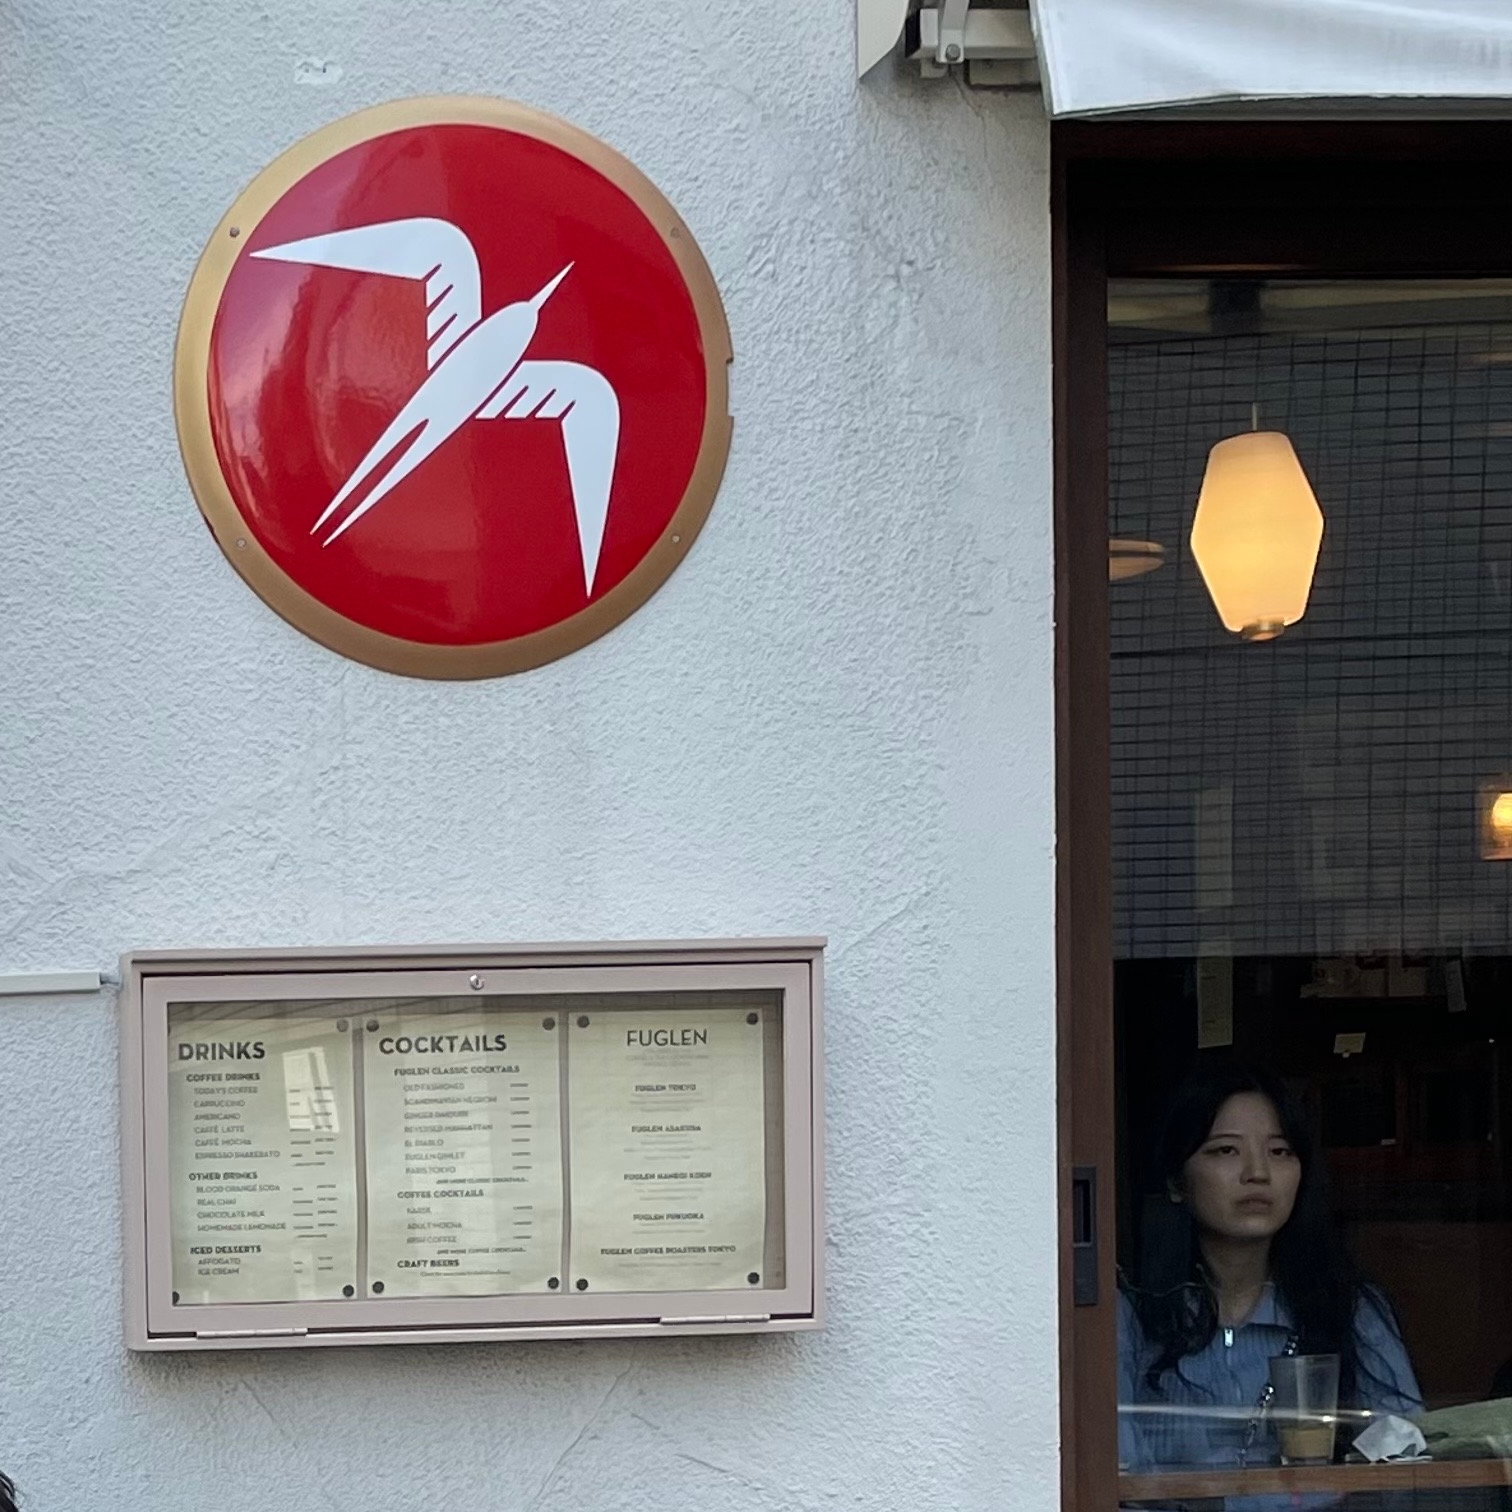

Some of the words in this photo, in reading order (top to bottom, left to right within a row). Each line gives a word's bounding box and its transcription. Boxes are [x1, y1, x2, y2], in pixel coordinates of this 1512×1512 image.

[627, 1029, 707, 1046] FUGLEN
[379, 1035, 506, 1054] COCKTAILS
[178, 1042, 265, 1061] DRINKS
[394, 1068, 429, 1076] FUGLEN
[432, 1067, 468, 1075] CLASSIC
[471, 1065, 520, 1073] COCKTAILS
[186, 1073, 223, 1083] COFFEE
[226, 1072, 260, 1081] DRINKS
[222, 1125, 244, 1133] LATTE
[189, 1172, 221, 1180] OTHER
[223, 1171, 257, 1179] DRINKS
[259, 1184, 280, 1192] SODA
[397, 1191, 431, 1199] COFFEE
[434, 1189, 484, 1198] COCKTAILS
[197, 1211, 244, 1219] CHOCOLATE
[190, 1246, 213, 1254] ICED
[216, 1245, 261, 1253] DESSERTS
[397, 1260, 427, 1268] CRAFT
[430, 1259, 460, 1267] BEERS
